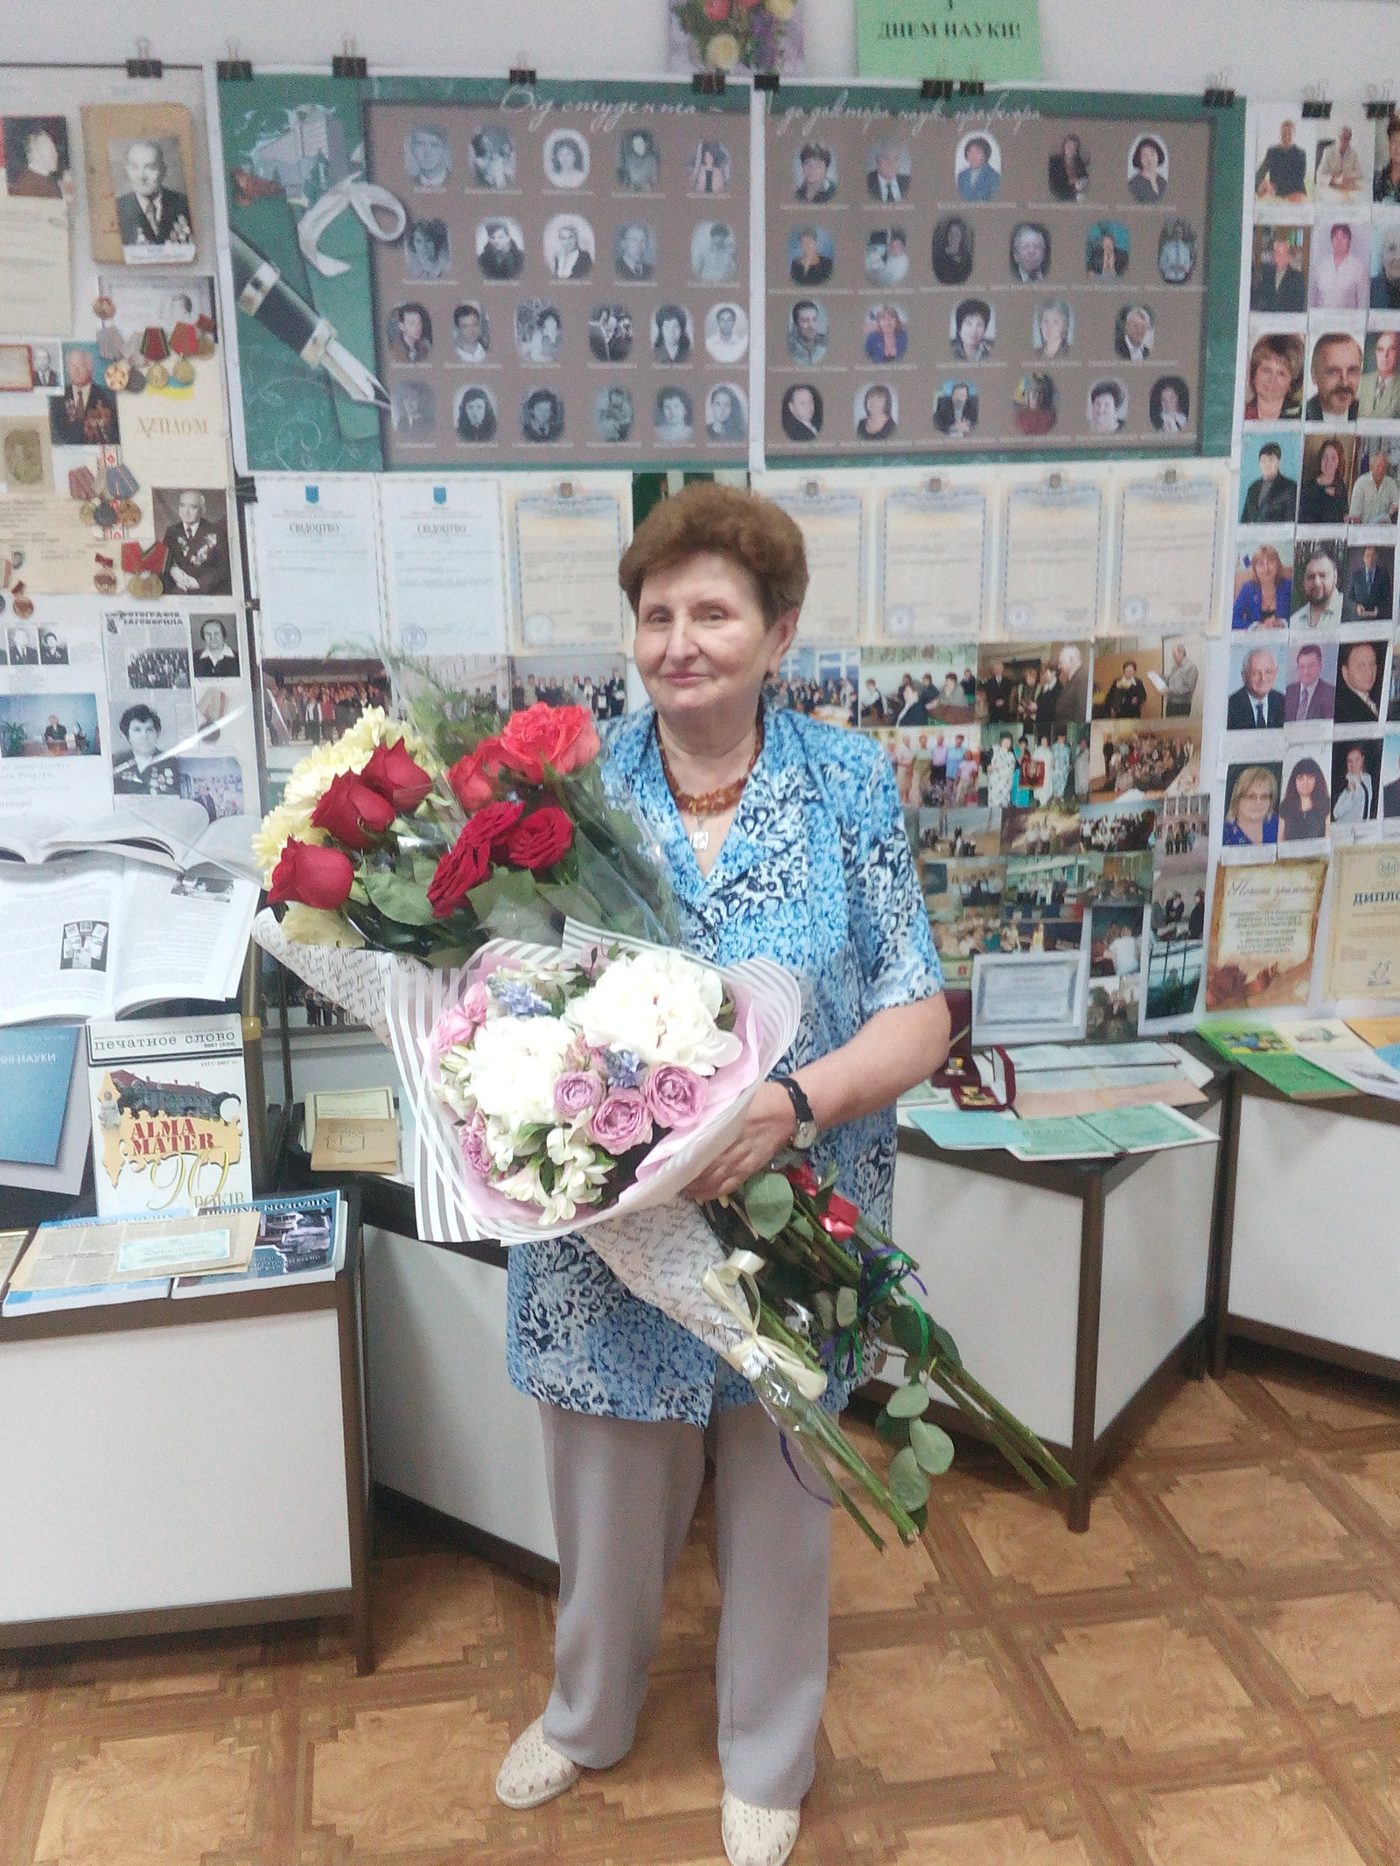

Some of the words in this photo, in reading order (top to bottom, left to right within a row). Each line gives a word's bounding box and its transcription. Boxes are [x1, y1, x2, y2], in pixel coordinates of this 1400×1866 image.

[878, 22, 937, 39] ДНЕМ
[944, 22, 1021, 38] НАУКИ!
[94, 1035, 177, 1051] печатное
[184, 1031, 235, 1045] слово
[131, 1118, 195, 1140] ALMA
[132, 1133, 214, 1156] MATER
[147, 1148, 231, 1211] 90
